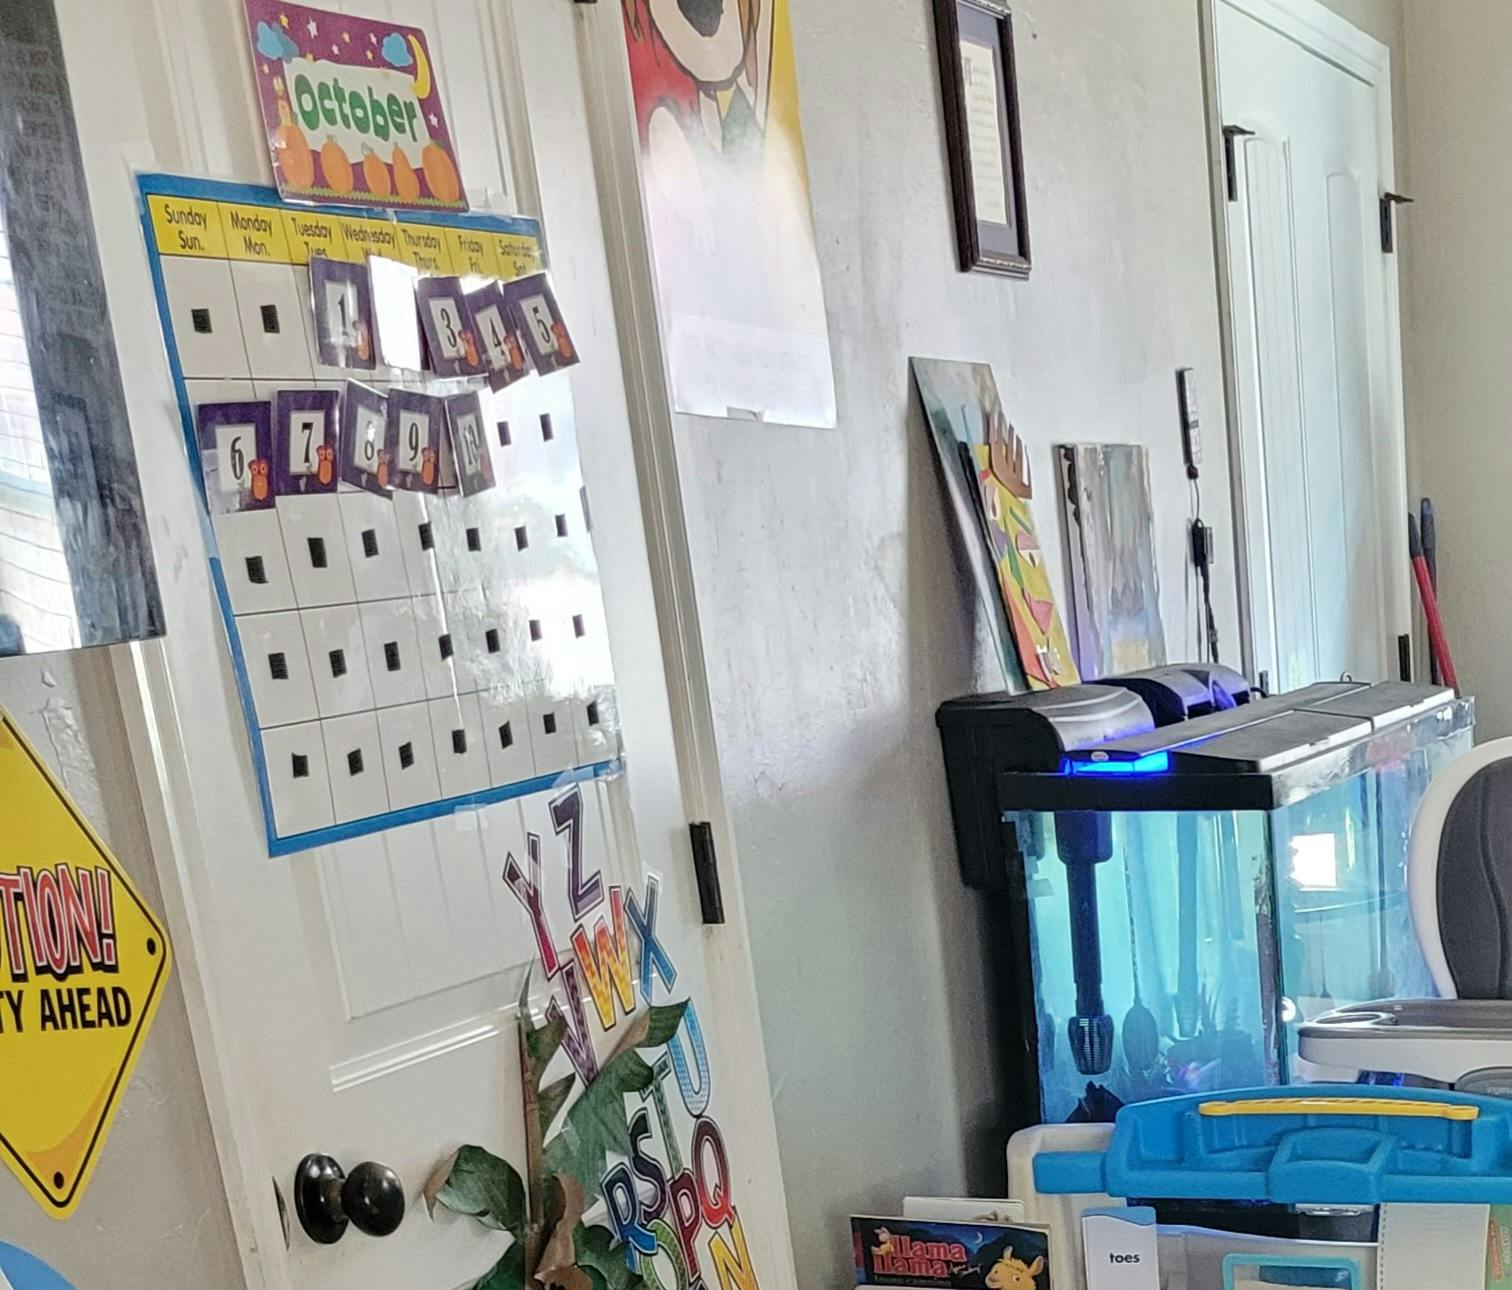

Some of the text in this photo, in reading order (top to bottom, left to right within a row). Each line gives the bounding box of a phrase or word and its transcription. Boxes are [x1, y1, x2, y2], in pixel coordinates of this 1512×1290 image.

[293, 73, 419, 142] October
[165, 204, 207, 229] Sunday
[231, 211, 272, 235] Monday
[291, 218, 332, 240] Tuesday
[343, 223, 395, 248] Wednesday
[402, 228, 441, 250] Thursday
[459, 235, 483, 255] Friday
[178, 230, 205, 250] Sun.
[243, 236, 271, 255] Mon.
[441, 308, 457, 347] 3
[489, 322, 502, 348] 4
[533, 306, 551, 345] 5
[230, 436, 244, 480] 6
[301, 422, 314, 464] 7
[364, 420, 375, 461] 8
[408, 422, 419, 461] 9
[502, 784, 604, 982] Y Z
[571, 885, 636, 1032] W
[624, 874, 678, 1006] X
[40, 986, 131, 1031] AHEAD
[640, 999, 711, 1178] T U
[601, 1108, 667, 1274] R S
[667, 1115, 735, 1283] P Q
[873, 1253, 948, 1278] llama
[889, 1235, 967, 1262] llama
[1109, 1252, 1140, 1265] toes
